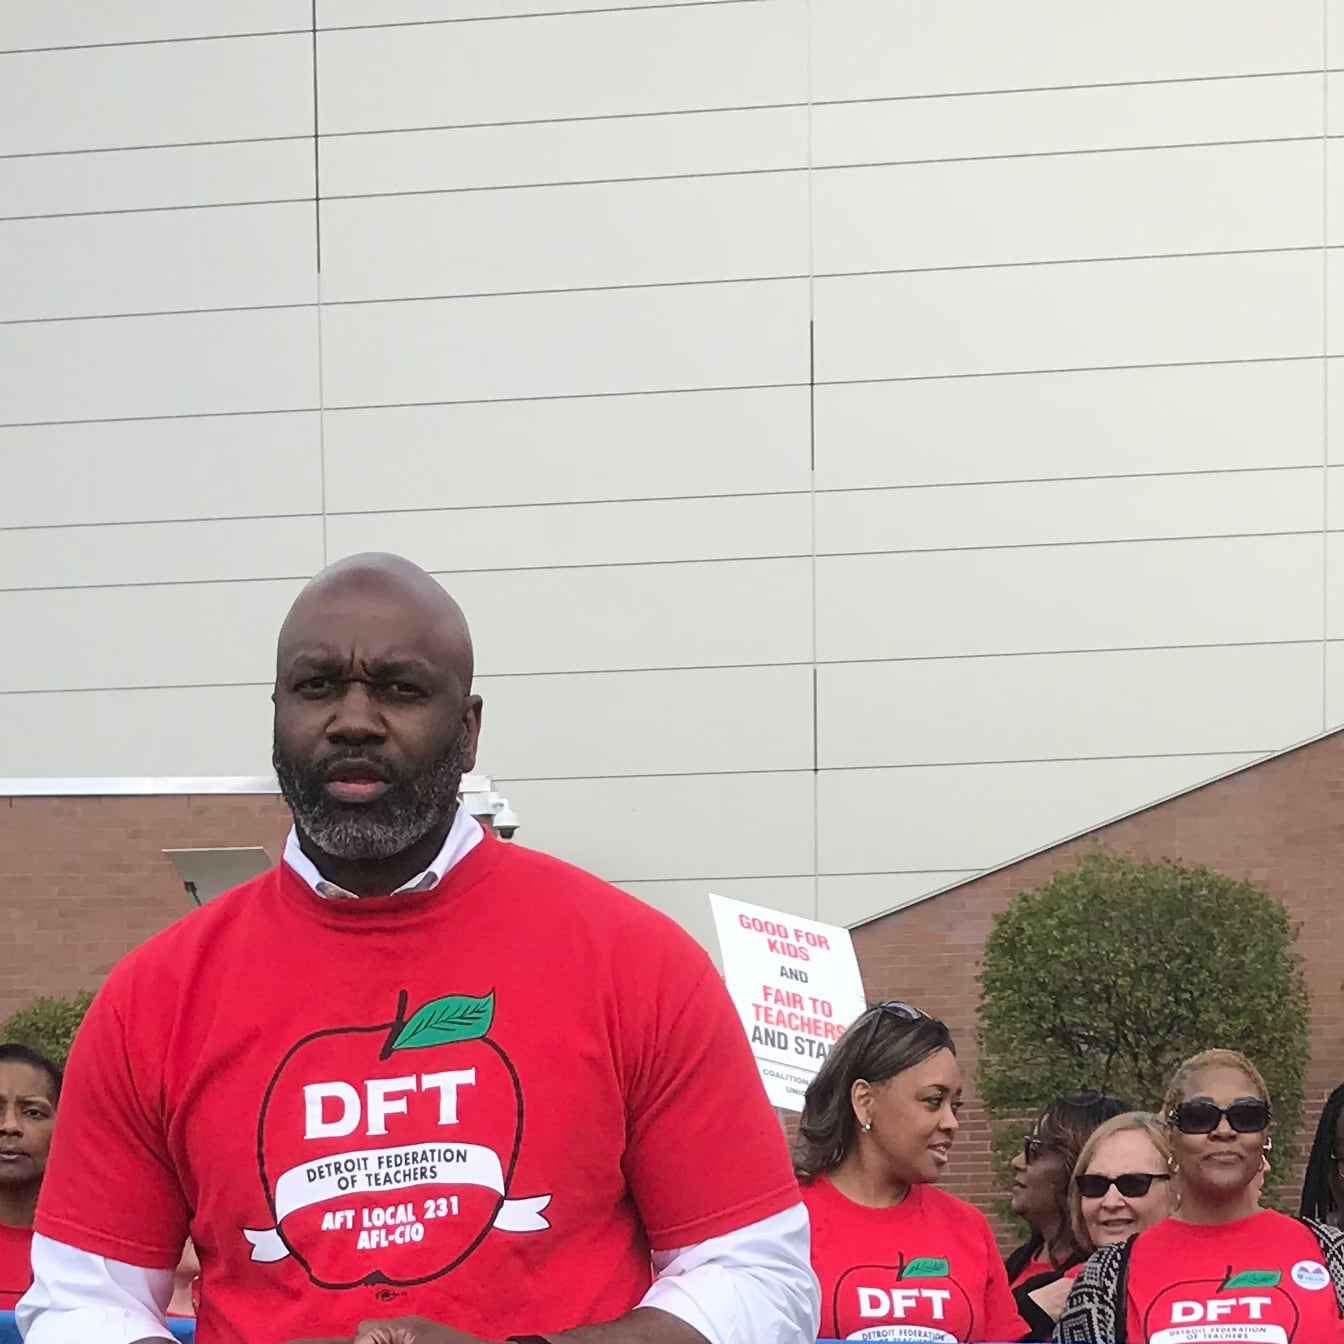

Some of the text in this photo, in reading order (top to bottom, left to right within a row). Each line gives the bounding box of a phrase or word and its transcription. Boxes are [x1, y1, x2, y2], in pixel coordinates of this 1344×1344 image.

[738, 914, 831, 951] GOOD FOR
[767, 938, 811, 962] KIDS
[779, 965, 809, 984] AND
[762, 985, 833, 1018] FAIR TO
[752, 1003, 848, 1042] TEACHERS
[751, 1025, 832, 1060] AND STA
[302, 1066, 476, 1140] DFT
[306, 1148, 468, 1183] DETROIT FEDERATION
[337, 1166, 438, 1191] OF TEACHERS
[321, 1195, 460, 1231] AFT LOCAL 231
[356, 1222, 424, 1251] AFL-CIO
[857, 1287, 951, 1319] DFT
[1170, 1296, 1272, 1323] DFT
[862, 1329, 895, 1340] DETROIT
[1169, 1326, 1267, 1337] DETROIT FEDERATION
[1203, 1332, 1249, 1340] TEACHERS
